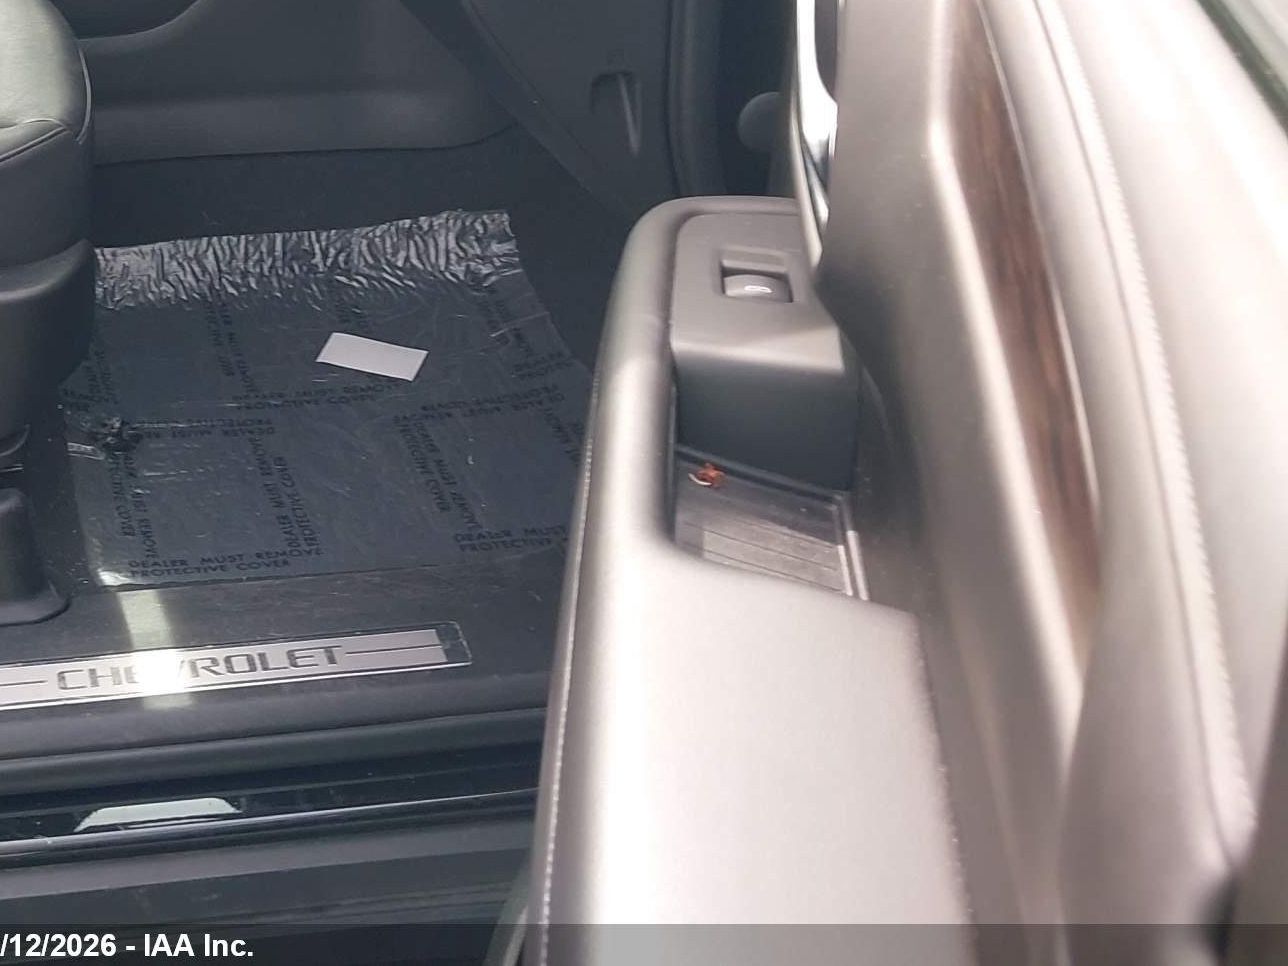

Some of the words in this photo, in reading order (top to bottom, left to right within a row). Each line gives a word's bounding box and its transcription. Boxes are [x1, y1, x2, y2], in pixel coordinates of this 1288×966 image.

[127, 559, 189, 569] DEALER
[200, 553, 244, 565] MUST
[255, 547, 324, 560] REMOVE
[130, 564, 228, 578] PROTECTIVE
[235, 558, 290, 571] COVER
[57, 644, 343, 690] CHEROLET
